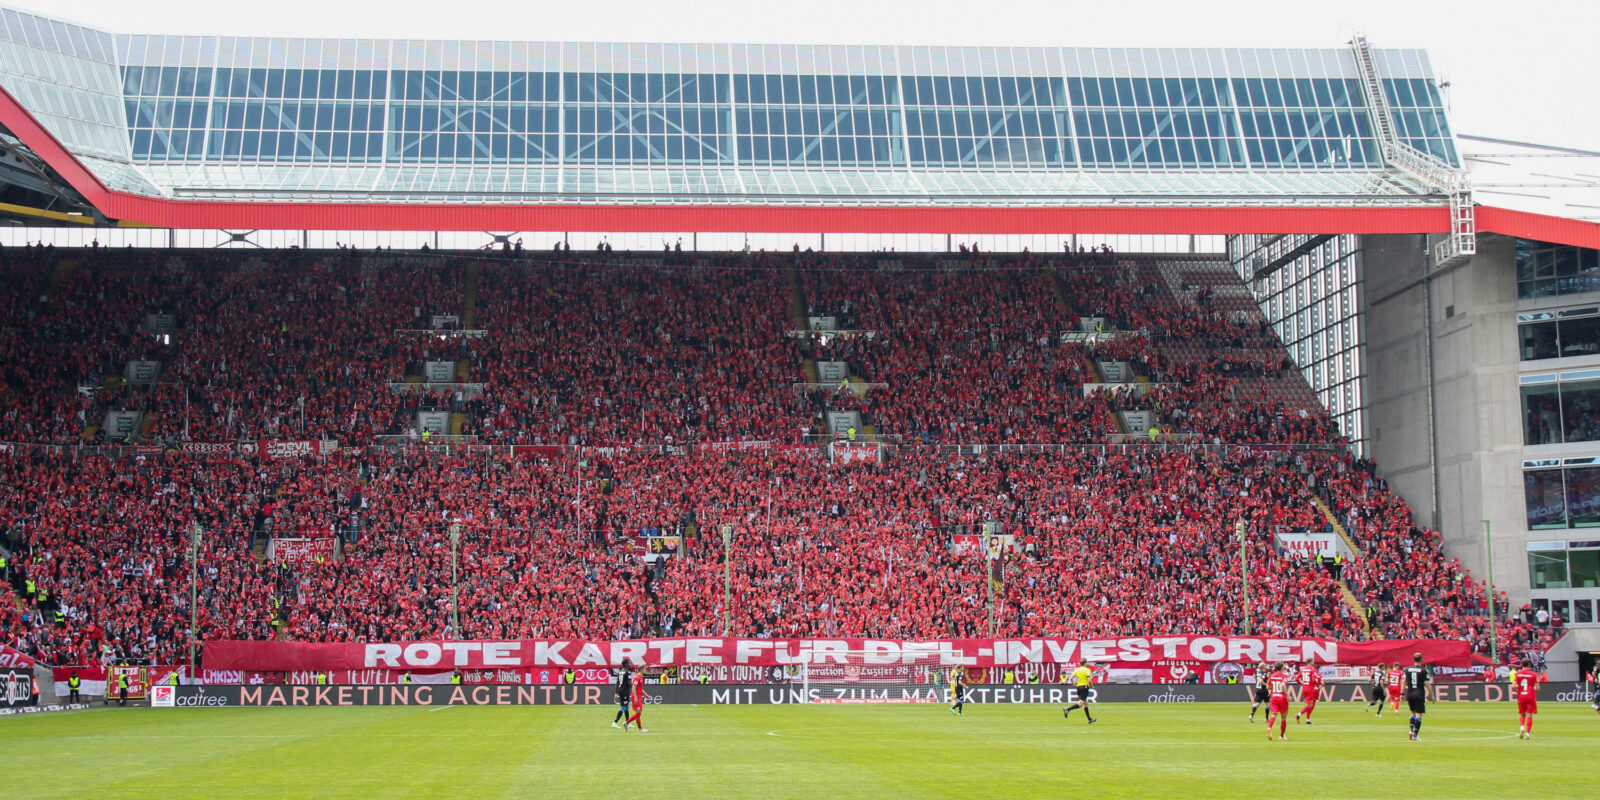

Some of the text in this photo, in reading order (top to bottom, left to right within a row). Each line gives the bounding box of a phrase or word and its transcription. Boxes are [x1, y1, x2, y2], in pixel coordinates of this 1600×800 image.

[364, 642, 522, 667] ROTE
[534, 638, 723, 666] KARTE
[735, 639, 850, 664] FÜR
[731, 665, 763, 681] YOUTH
[897, 667, 909, 676] 98
[1301, 672, 1311, 682] 16
[1389, 674, 1400, 684] 23
[1520, 678, 1528, 690] 4
[1271, 681, 1283, 693] 10
[176, 690, 228, 706] adtree
[240, 686, 433, 706] MARKETING
[448, 686, 601, 706] AGENTUR
[713, 688, 757, 705] MIT
[769, 688, 820, 705] UNS
[1148, 688, 1196, 703] adtree
